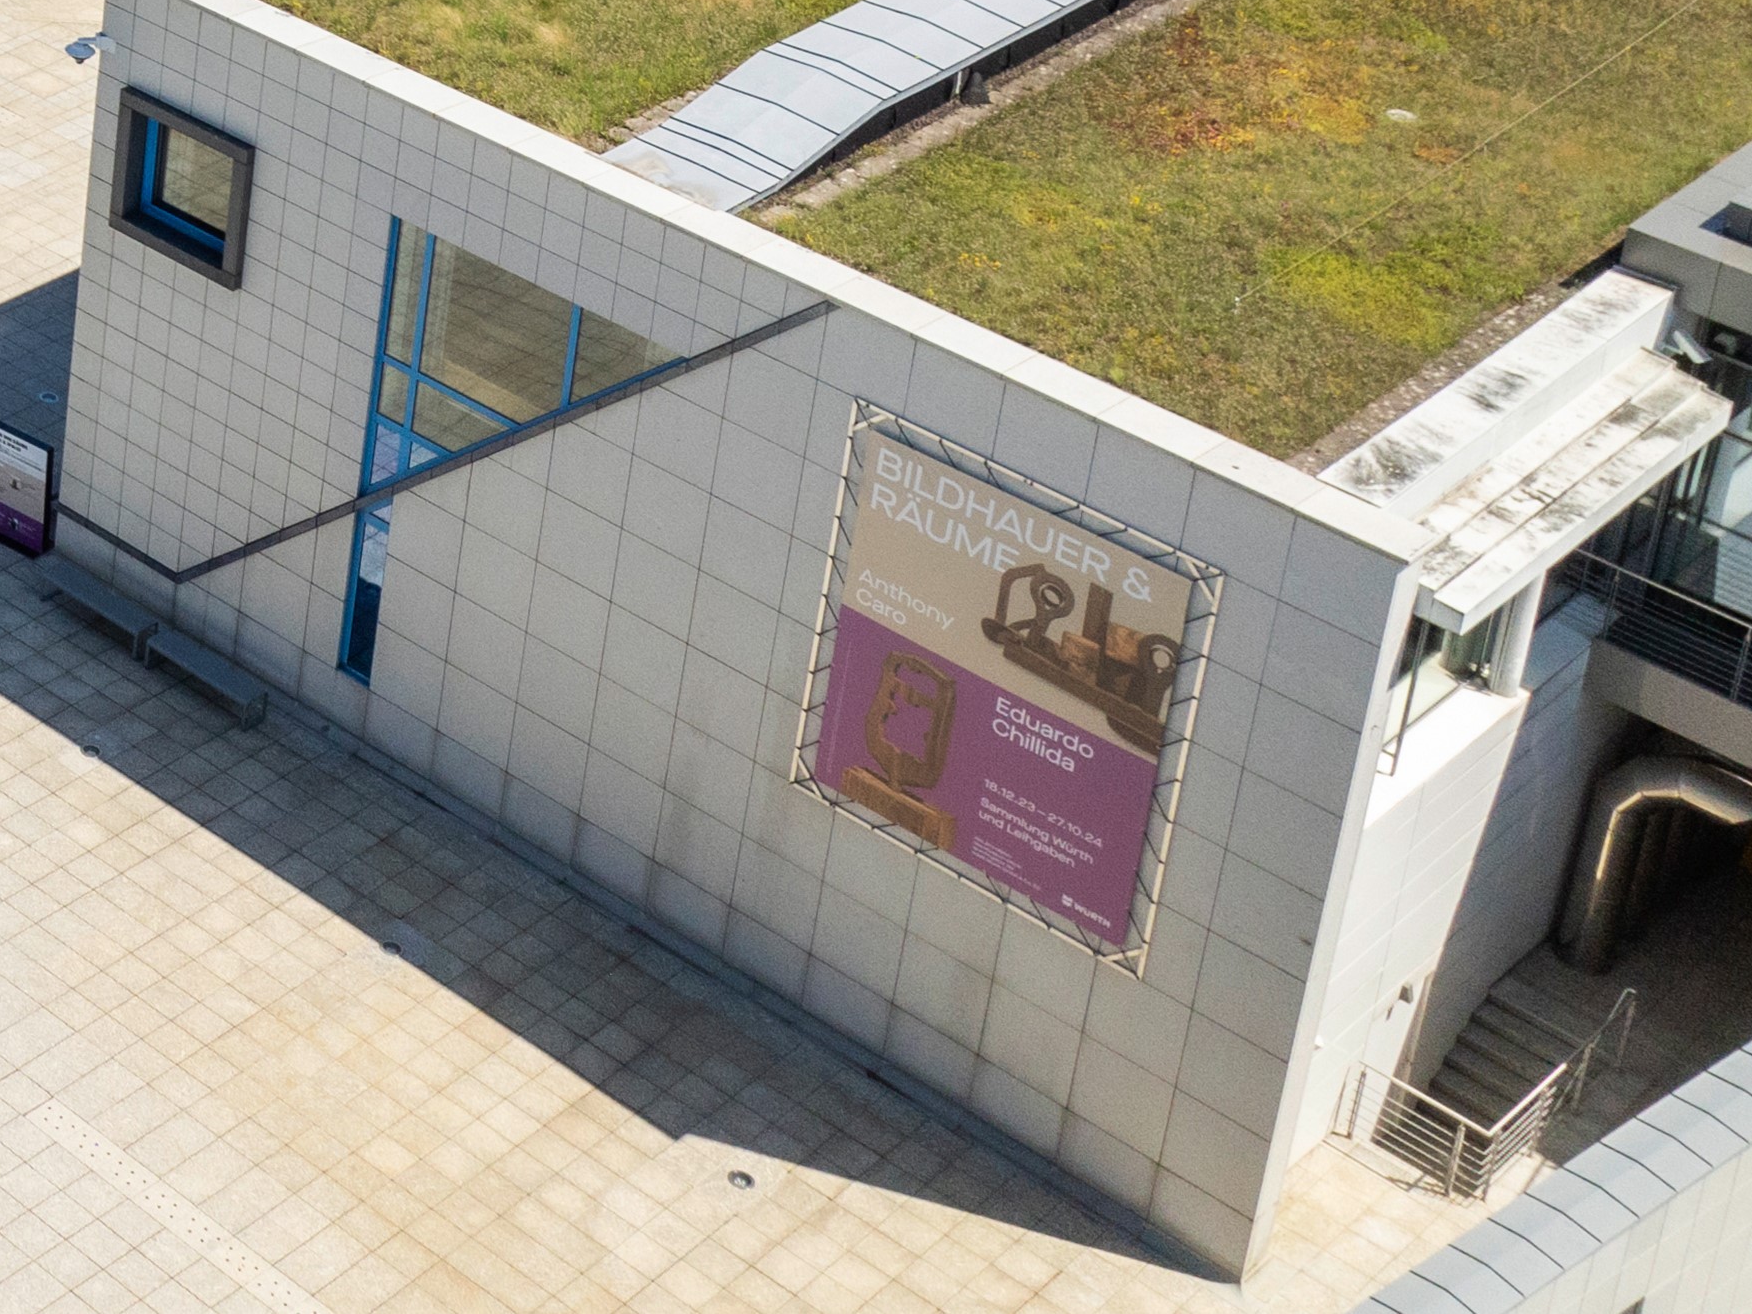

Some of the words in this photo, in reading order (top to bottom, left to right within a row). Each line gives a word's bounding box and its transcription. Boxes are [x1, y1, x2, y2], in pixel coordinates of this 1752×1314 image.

[869, 482, 1022, 573] RÄUME
[875, 447, 1113, 583] BILDHAUER
[1121, 565, 1153, 603] &
[855, 587, 907, 626] Caro
[858, 568, 955, 631] Anthony
[992, 718, 1075, 772] Chillida
[995, 696, 1094, 759] Eduardo
[978, 810, 1004, 830] und
[1006, 823, 1076, 868] Leihgaben
[980, 796, 1050, 843] Sammlung
[1052, 835, 1094, 865] Würth
[984, 778, 1036, 812] 18.12.23
[1047, 812, 1103, 848] 27.10.24
